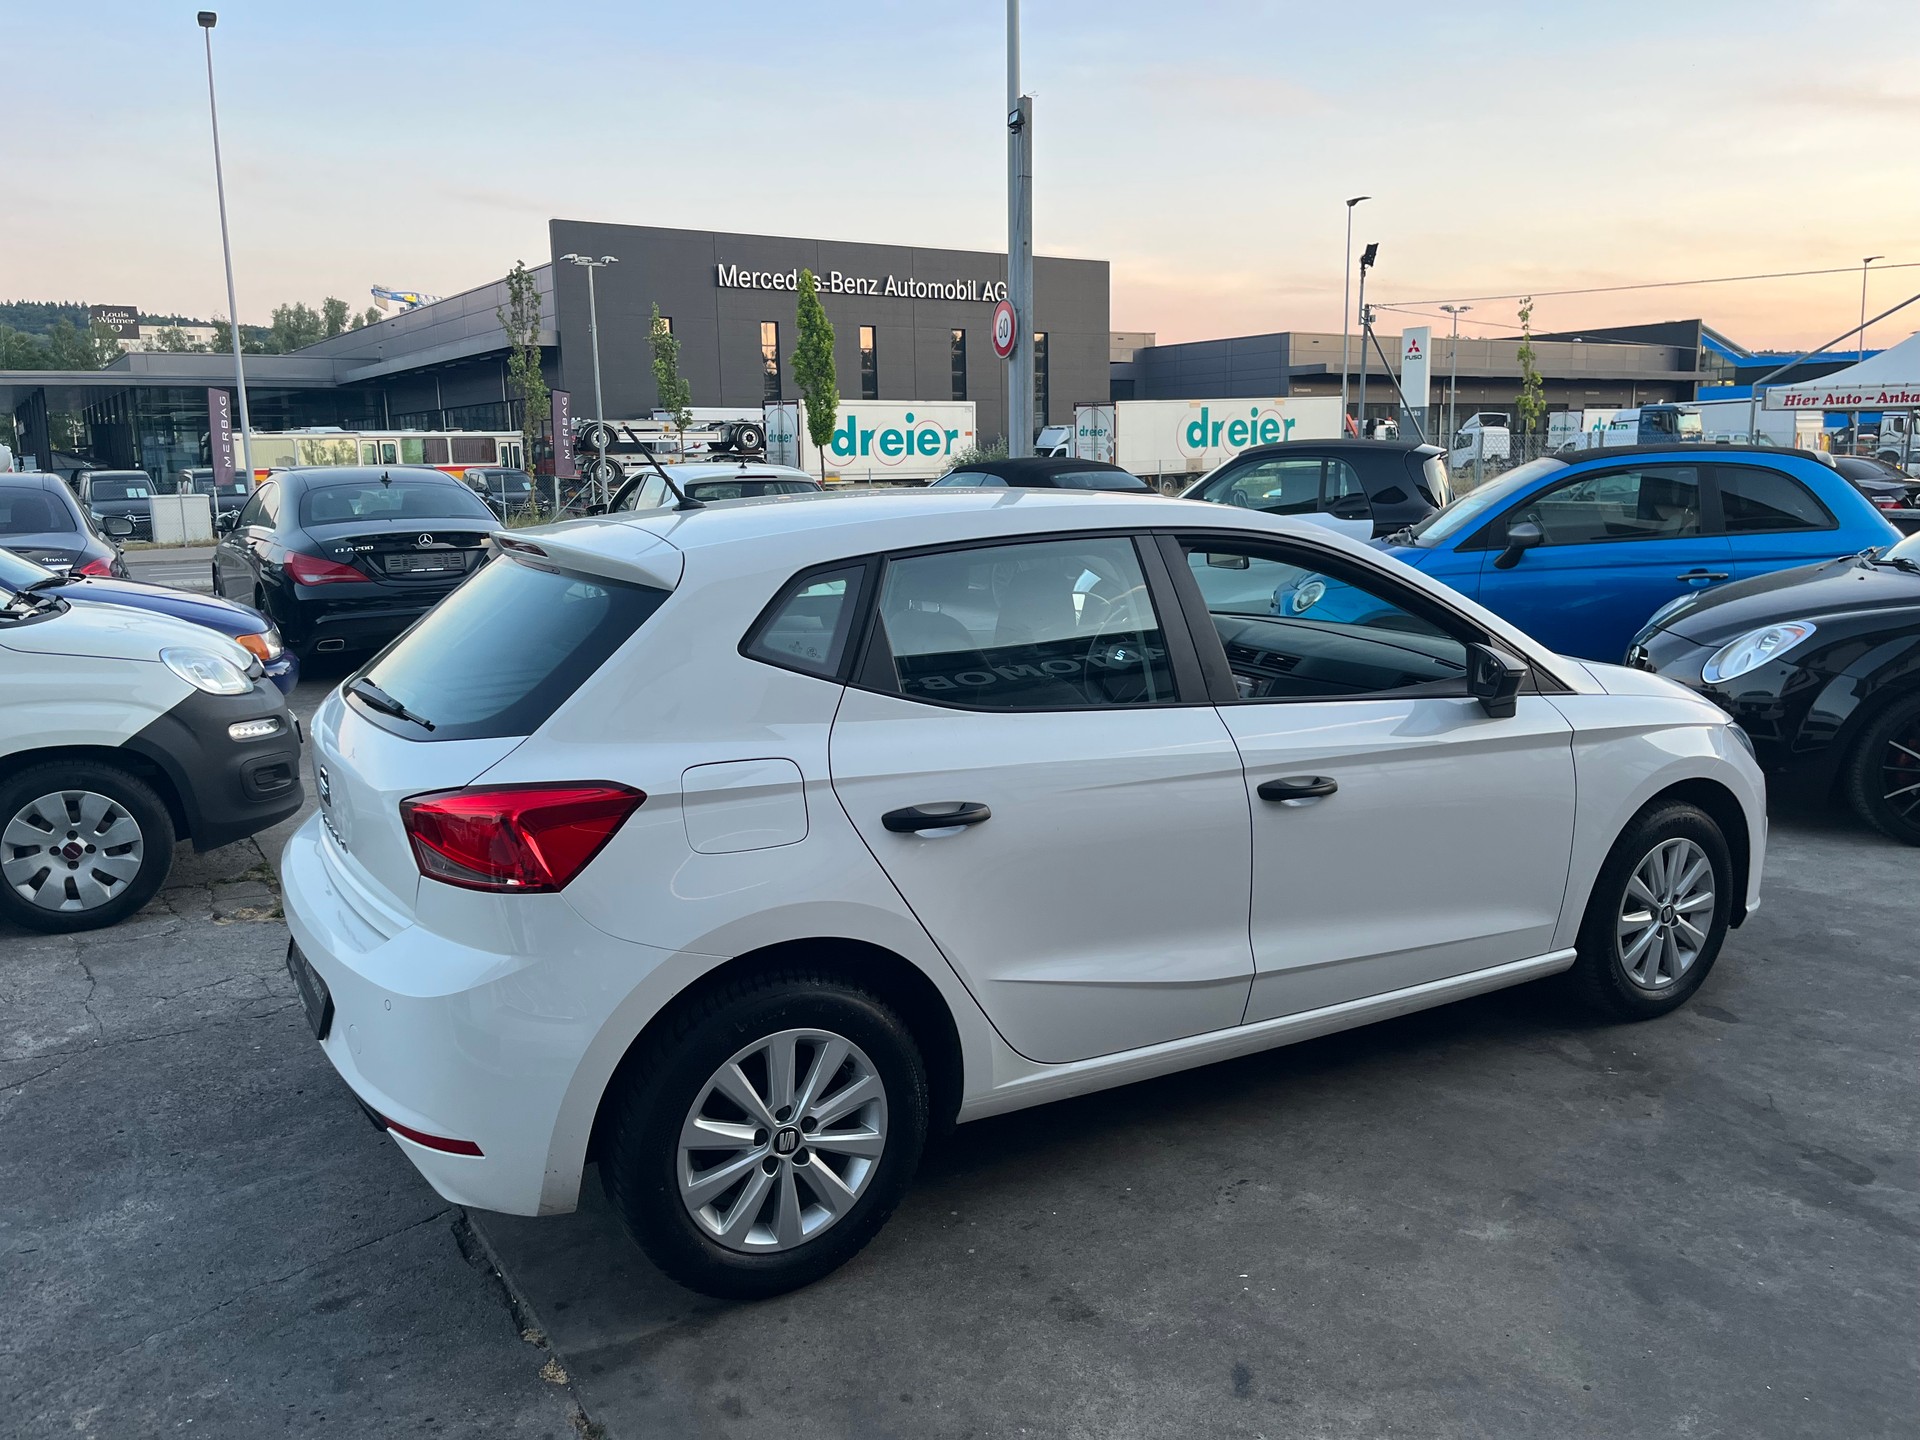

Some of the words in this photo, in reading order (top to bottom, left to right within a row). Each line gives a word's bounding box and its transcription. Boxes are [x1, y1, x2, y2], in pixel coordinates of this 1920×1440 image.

[718, 263, 877, 295] Merceds-Benz
[982, 281, 1007, 302] AG
[97, 316, 136, 324] Widmer
[102, 310, 129, 318] Louis
[998, 318, 1008, 338] 60
[1783, 394, 1819, 406] Hier
[219, 396, 232, 468] MERBAG
[561, 397, 571, 460] MERBAG
[831, 412, 958, 457] dreier
[1079, 425, 1107, 437] dreier
[1186, 407, 1295, 448] dreier
